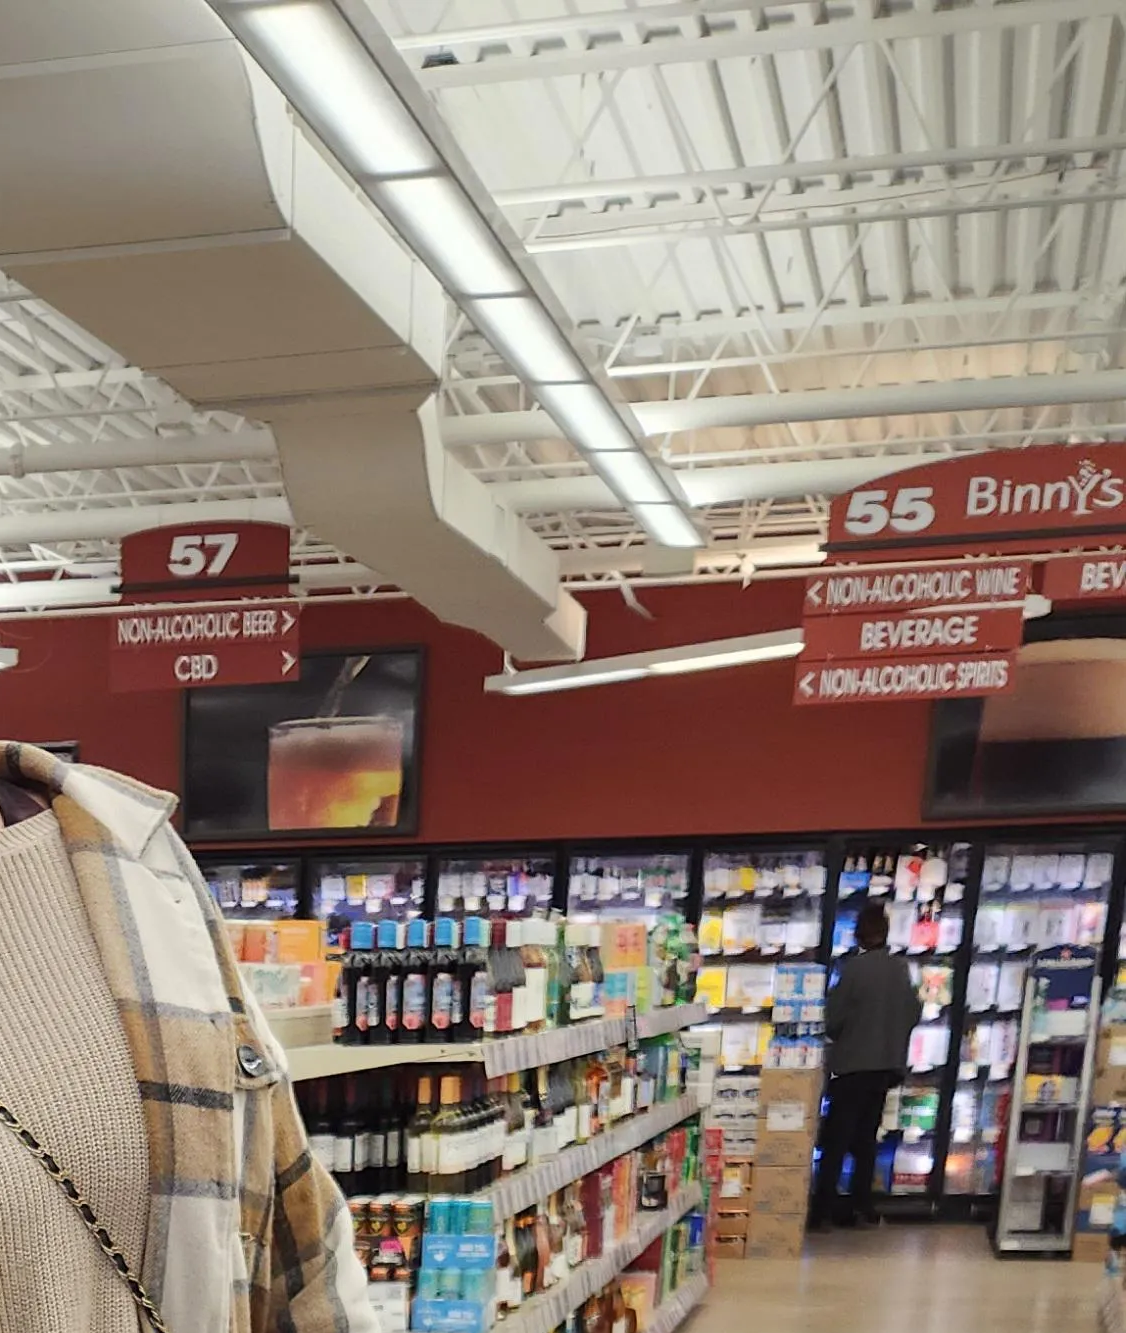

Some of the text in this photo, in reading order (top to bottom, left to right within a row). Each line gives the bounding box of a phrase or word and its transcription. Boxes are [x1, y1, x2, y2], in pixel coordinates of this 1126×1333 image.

[844, 487, 935, 535] 55
[167, 533, 239, 578] 57
[826, 567, 1021, 606] NON-ALCOHOLIC WINE
[118, 609, 277, 645] NON-ALCOHOLIC BEER
[860, 616, 980, 651] BEVERAGE
[174, 654, 219, 681] CBD
[819, 660, 1009, 699] NON-ALCOHOLIC SPIRITS
